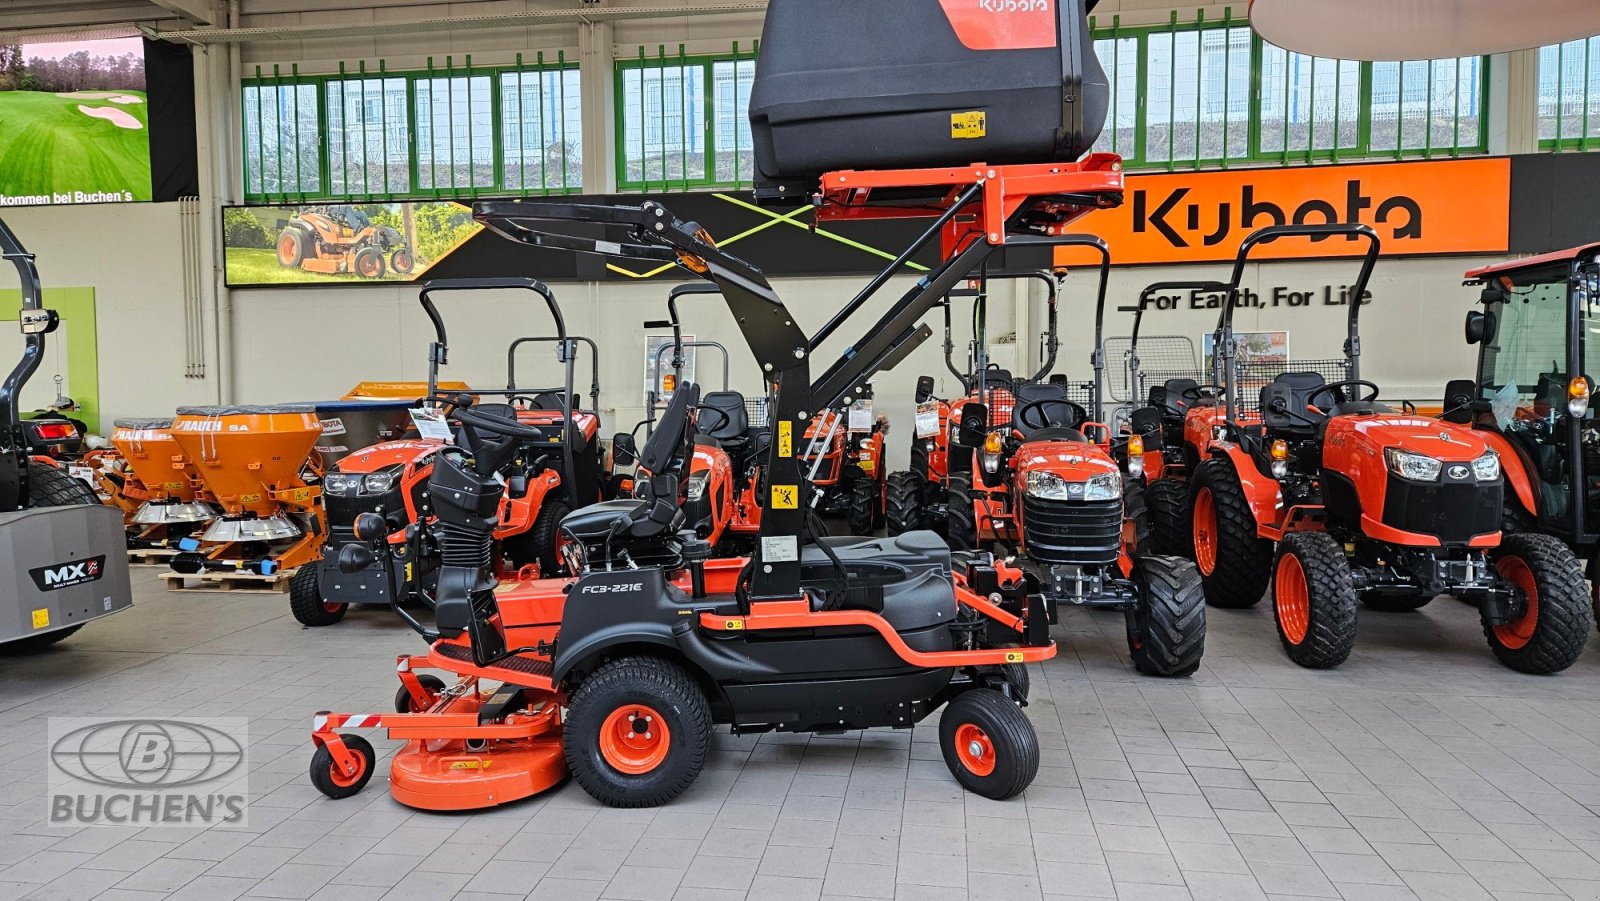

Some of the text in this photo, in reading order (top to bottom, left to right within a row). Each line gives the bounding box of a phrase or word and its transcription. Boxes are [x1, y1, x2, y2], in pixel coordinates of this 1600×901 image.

[53, 191, 72, 204] bei
[1133, 180, 1422, 248] Kubota
[1273, 286, 1314, 307] For
[181, 421, 222, 431] RAUCH
[44, 562, 86, 584] MX
[581, 582, 643, 594] FC3-221E
